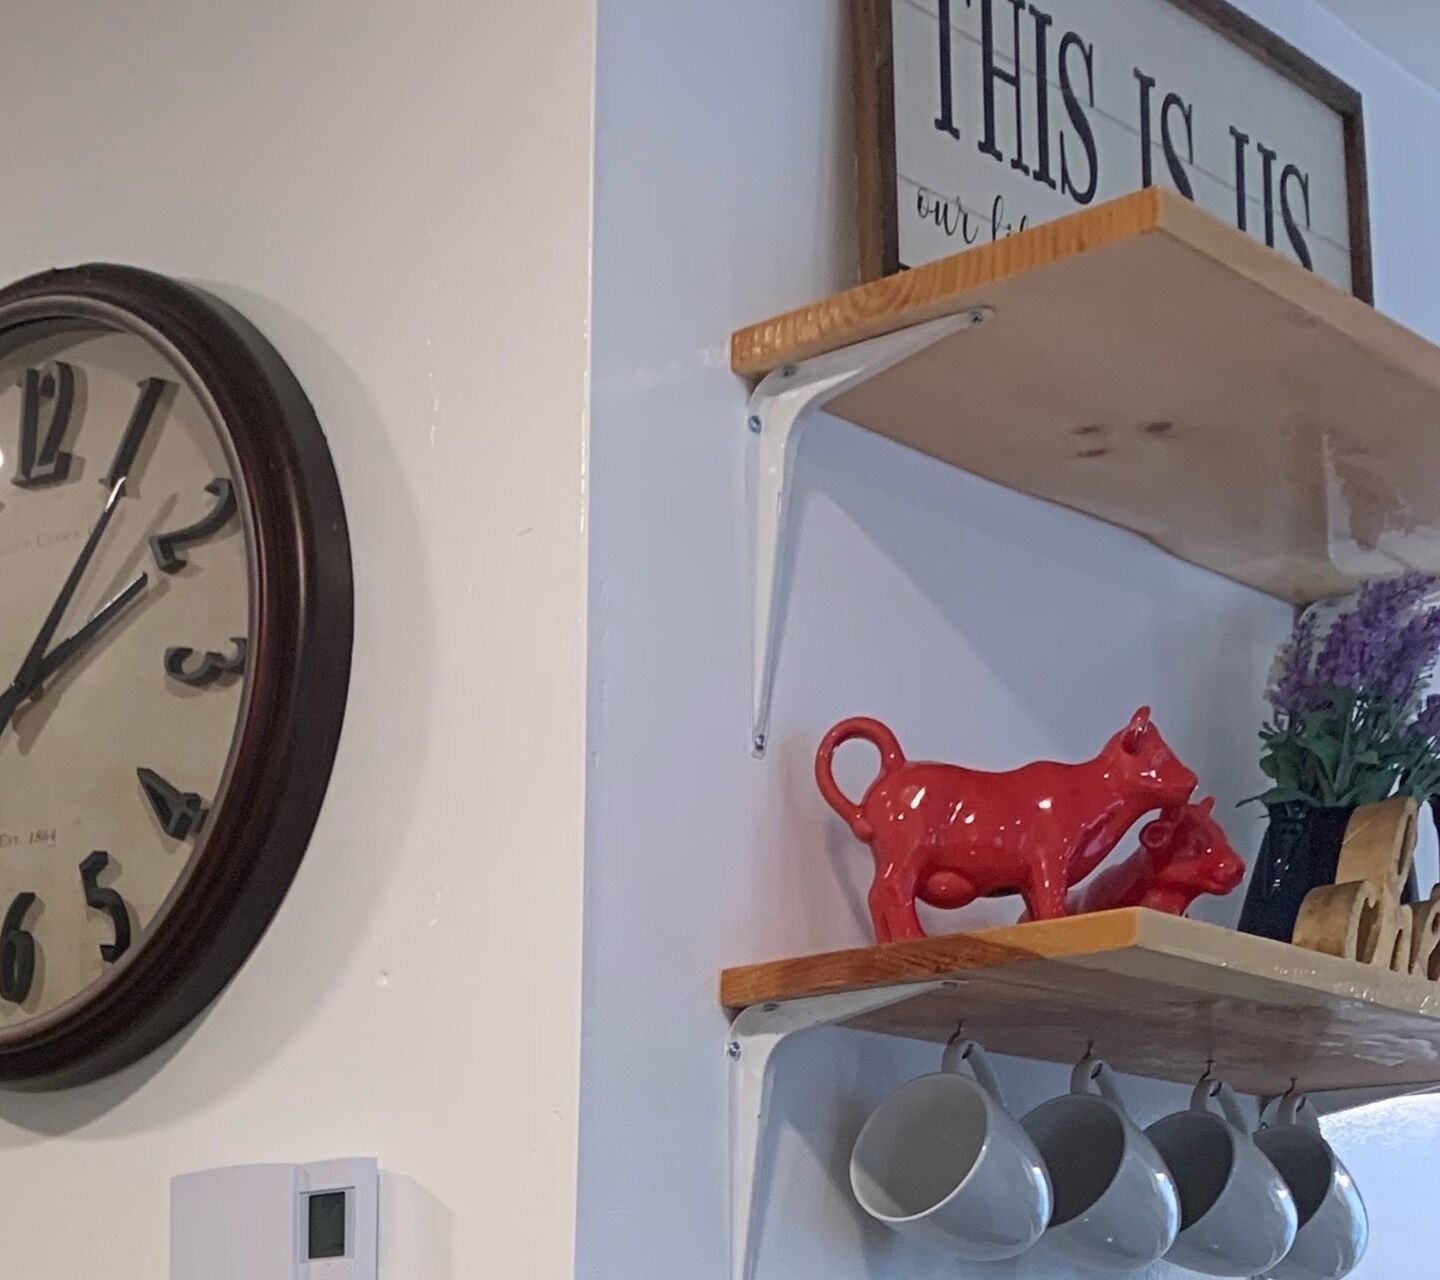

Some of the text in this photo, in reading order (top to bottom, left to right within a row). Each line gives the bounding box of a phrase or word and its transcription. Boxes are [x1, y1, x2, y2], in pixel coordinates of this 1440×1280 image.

[934, 0, 1098, 205] THIS
[917, 187, 979, 244] our
[13, 360, 78, 488] 12
[102, 376, 180, 488] 1
[148, 477, 238, 573] 2
[165, 636, 248, 686] 3
[136, 766, 208, 842] 4
[80, 851, 131, 962] 5
